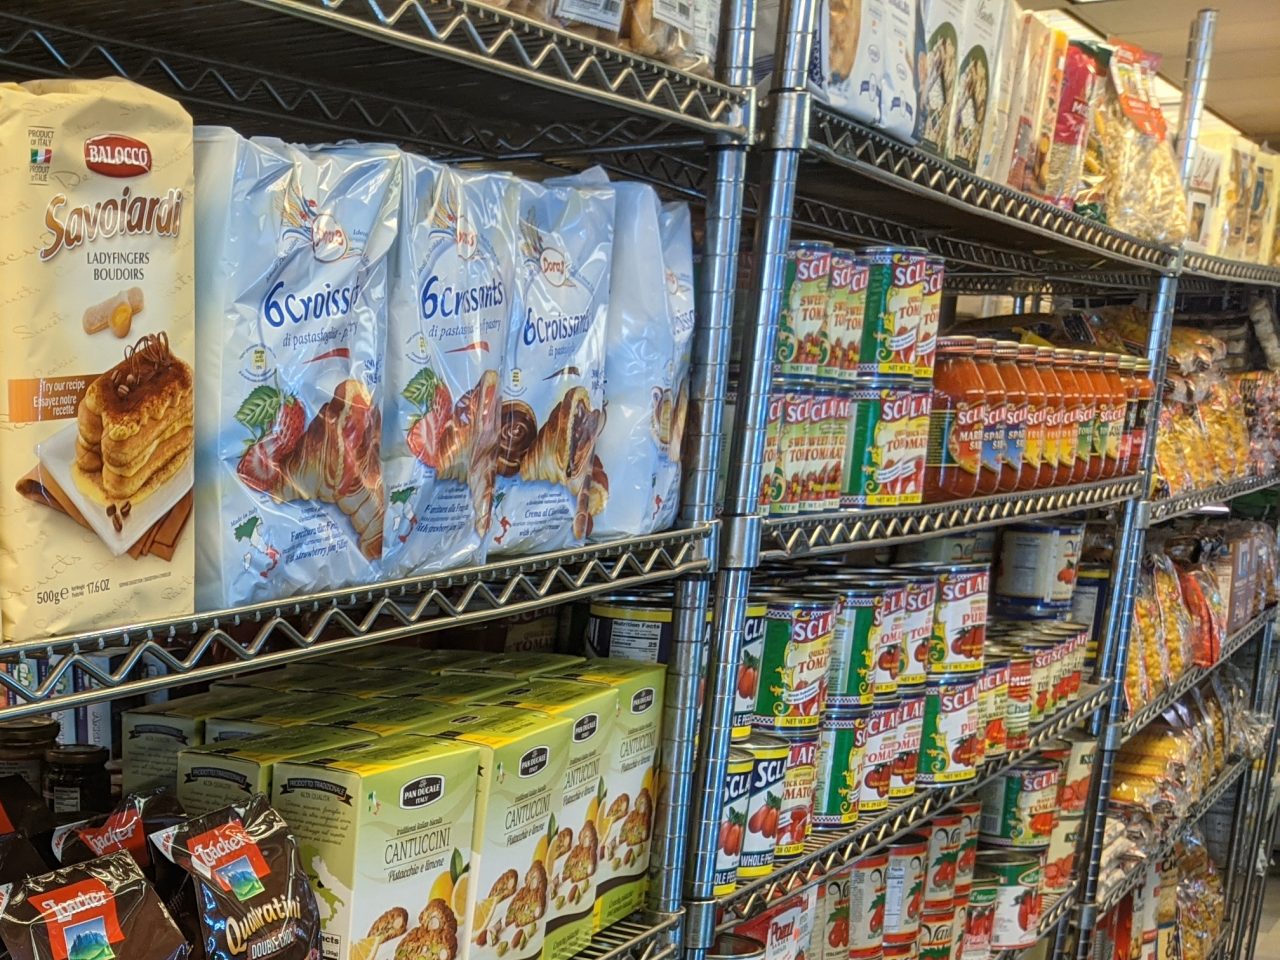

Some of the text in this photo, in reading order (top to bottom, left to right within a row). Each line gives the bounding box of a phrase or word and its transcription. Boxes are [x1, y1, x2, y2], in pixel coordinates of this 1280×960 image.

[89, 147, 148, 166] BALOCCO
[40, 186, 182, 261] Savoiardi
[87, 252, 150, 264] LADYFINGERS
[93, 267, 144, 280] BOUDOIRS
[943, 576, 988, 600] SCLA
[794, 615, 832, 641] SCLA
[942, 686, 978, 711] SCLA
[754, 760, 786, 788] SCLA
[505, 793, 551, 830] CANTUCCINI
[384, 828, 451, 864] CANTUCCINI
[225, 896, 301, 955] Quadratini
